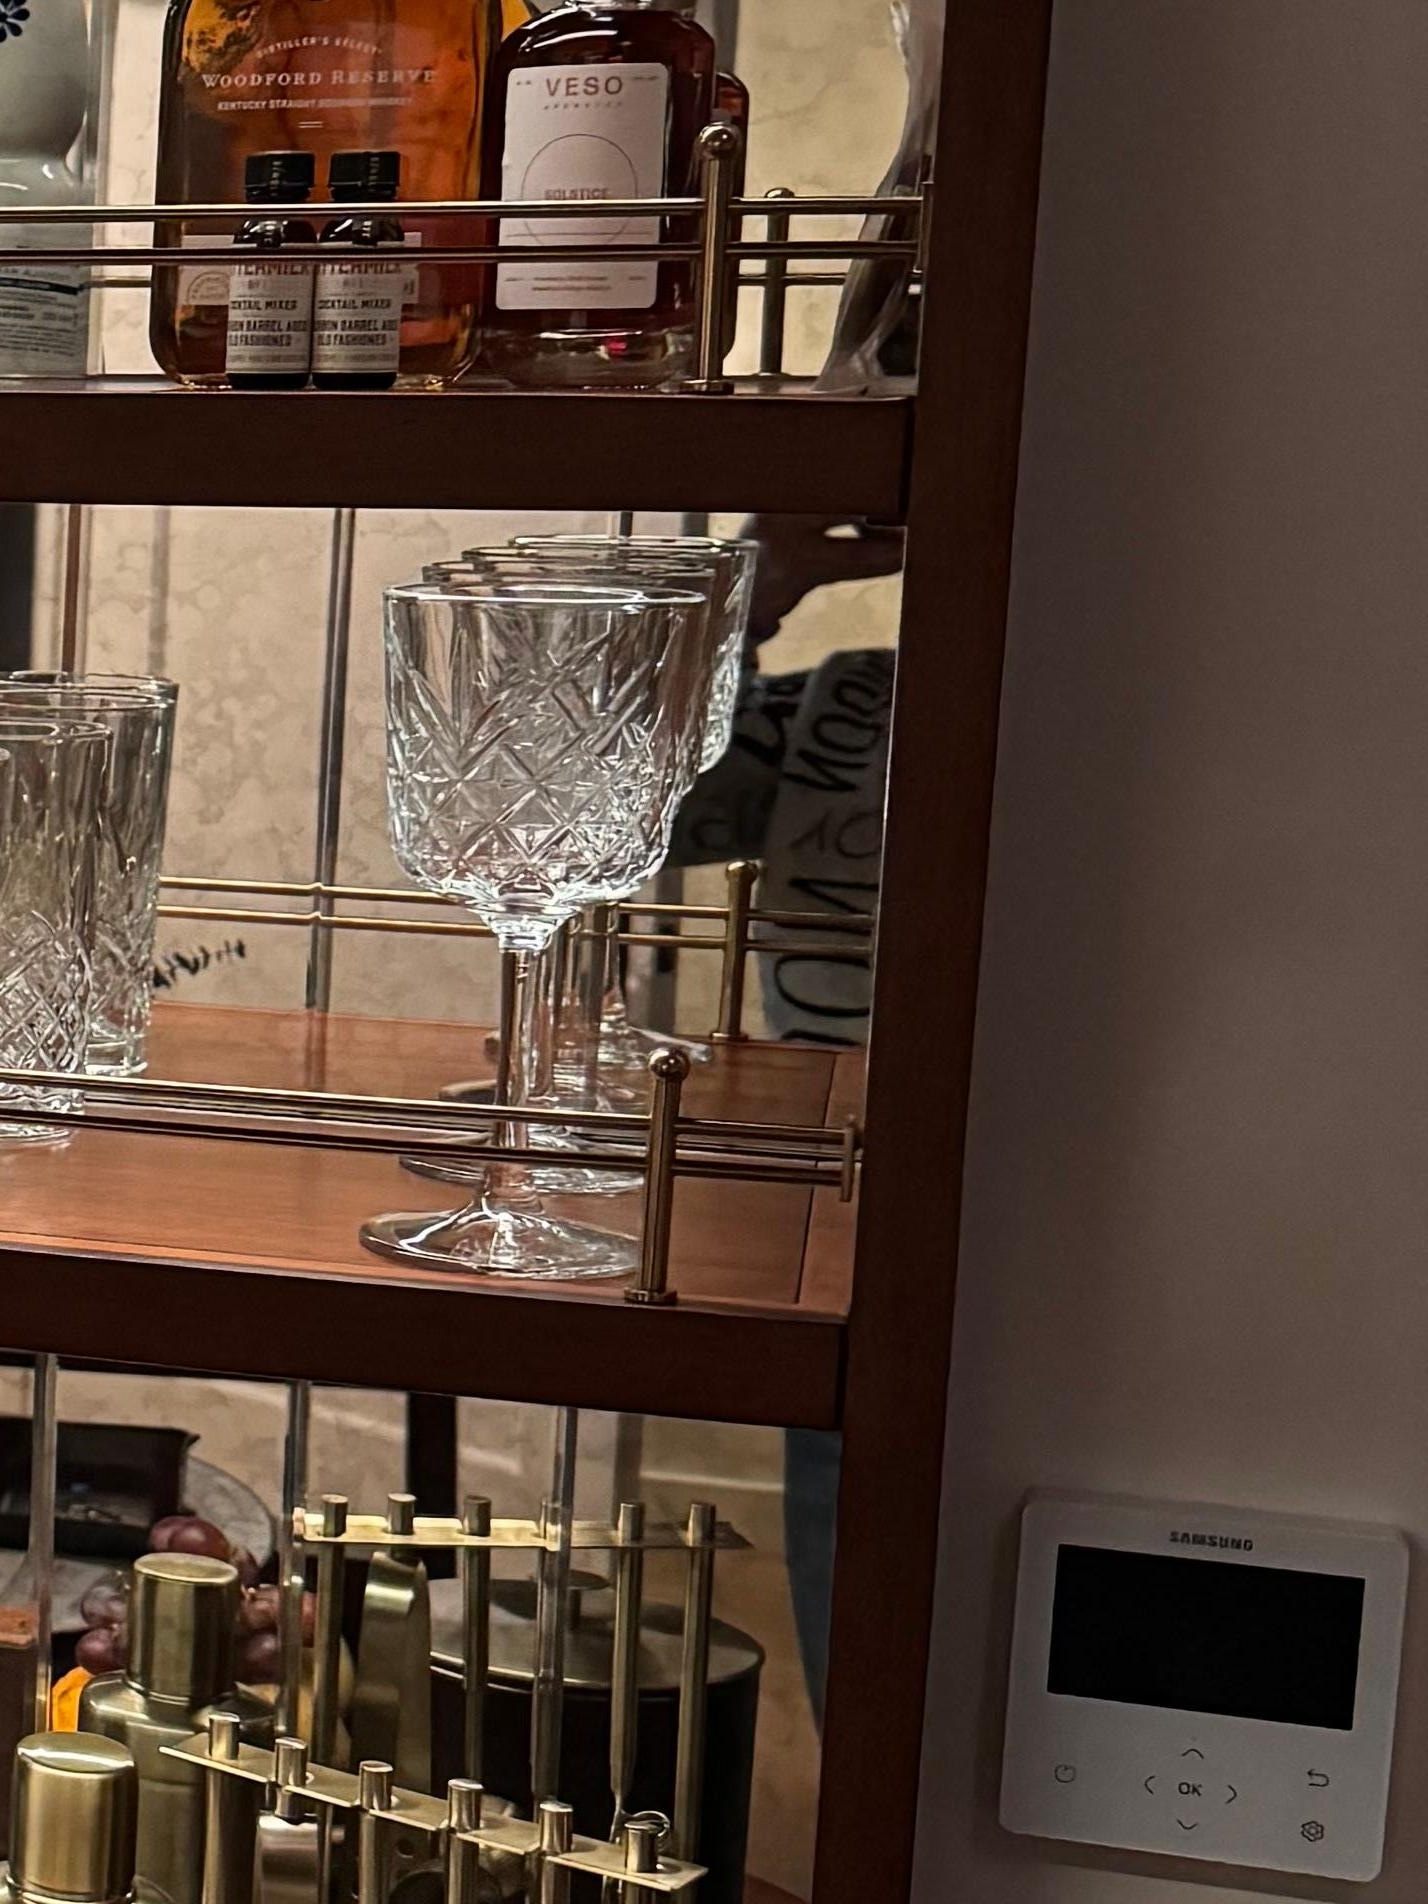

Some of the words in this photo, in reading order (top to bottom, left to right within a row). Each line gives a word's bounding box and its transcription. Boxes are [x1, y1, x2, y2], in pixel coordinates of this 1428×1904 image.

[201, 72, 322, 89] WOODFORD
[331, 69, 436, 85] RESERVE
[546, 75, 624, 96] VESO
[1169, 1530, 1254, 1552] SAMSUNG
[1178, 1781, 1203, 1797] OK
